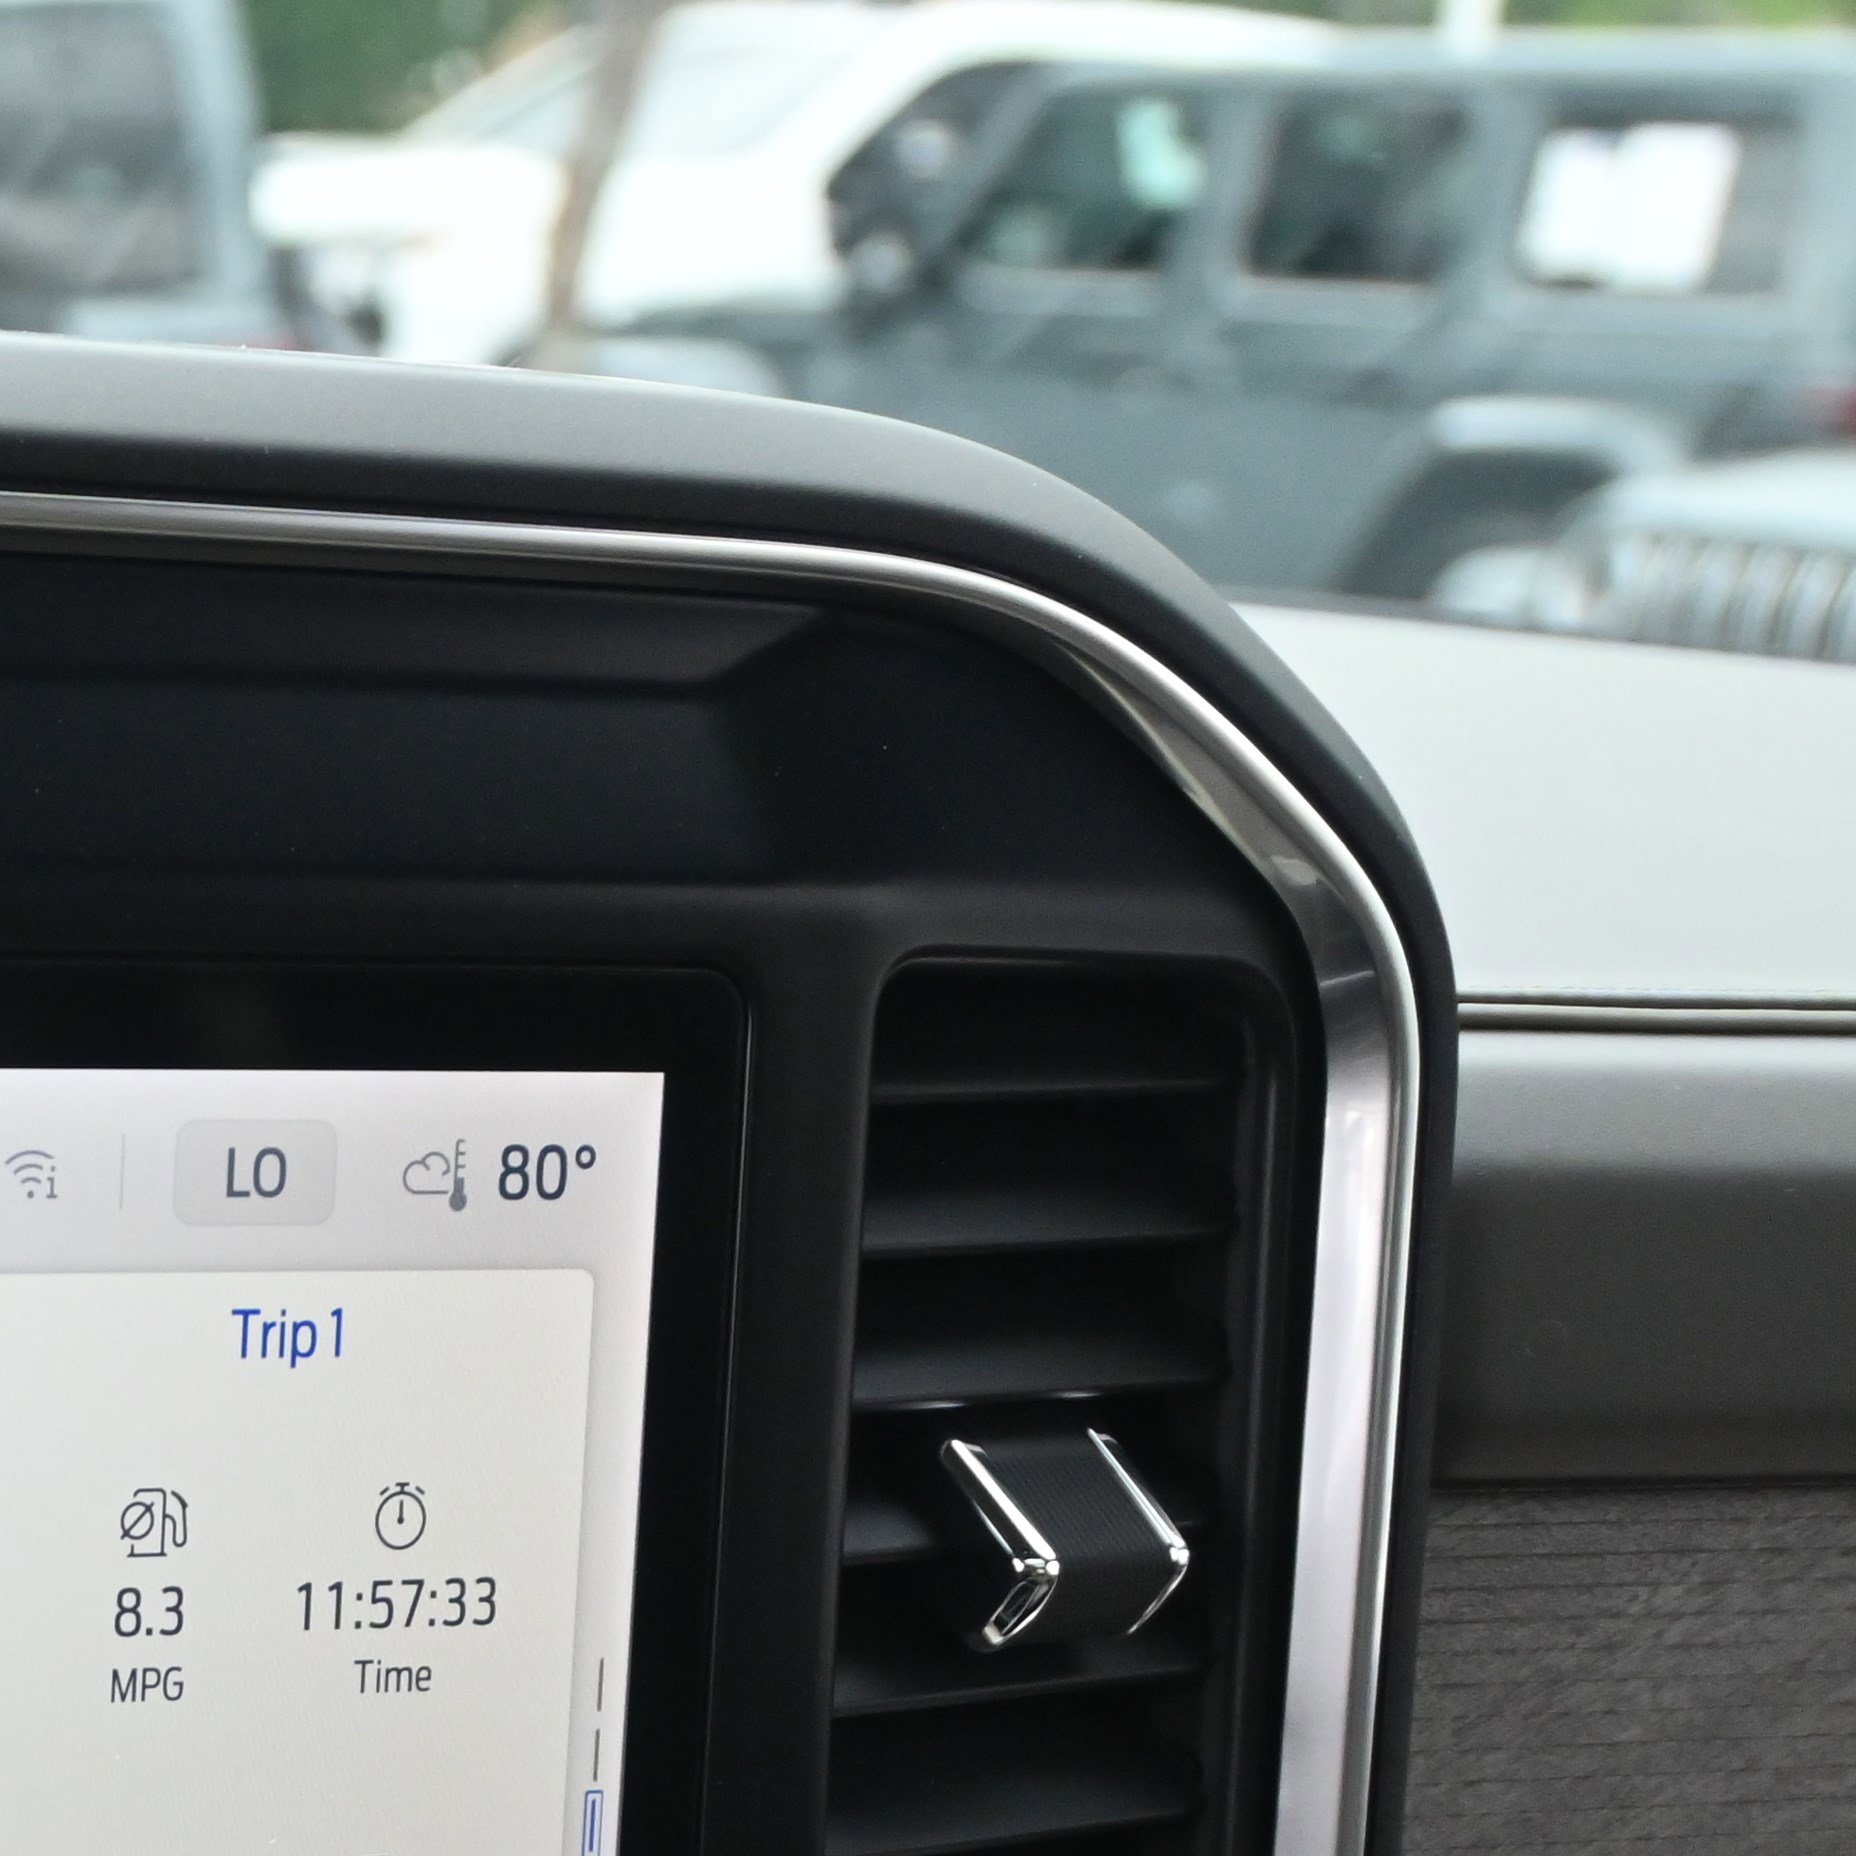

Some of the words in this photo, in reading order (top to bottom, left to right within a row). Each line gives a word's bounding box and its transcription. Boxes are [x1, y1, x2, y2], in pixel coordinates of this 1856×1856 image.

[226, 1147, 287, 1198] LO
[231, 1308, 317, 1368] Trip
[331, 1308, 343, 1357] 1
[114, 1585, 184, 1638] 8.3
[297, 1576, 496, 1631] 11:57:33
[111, 1666, 184, 1702] MPG
[354, 1659, 432, 1694] Time
